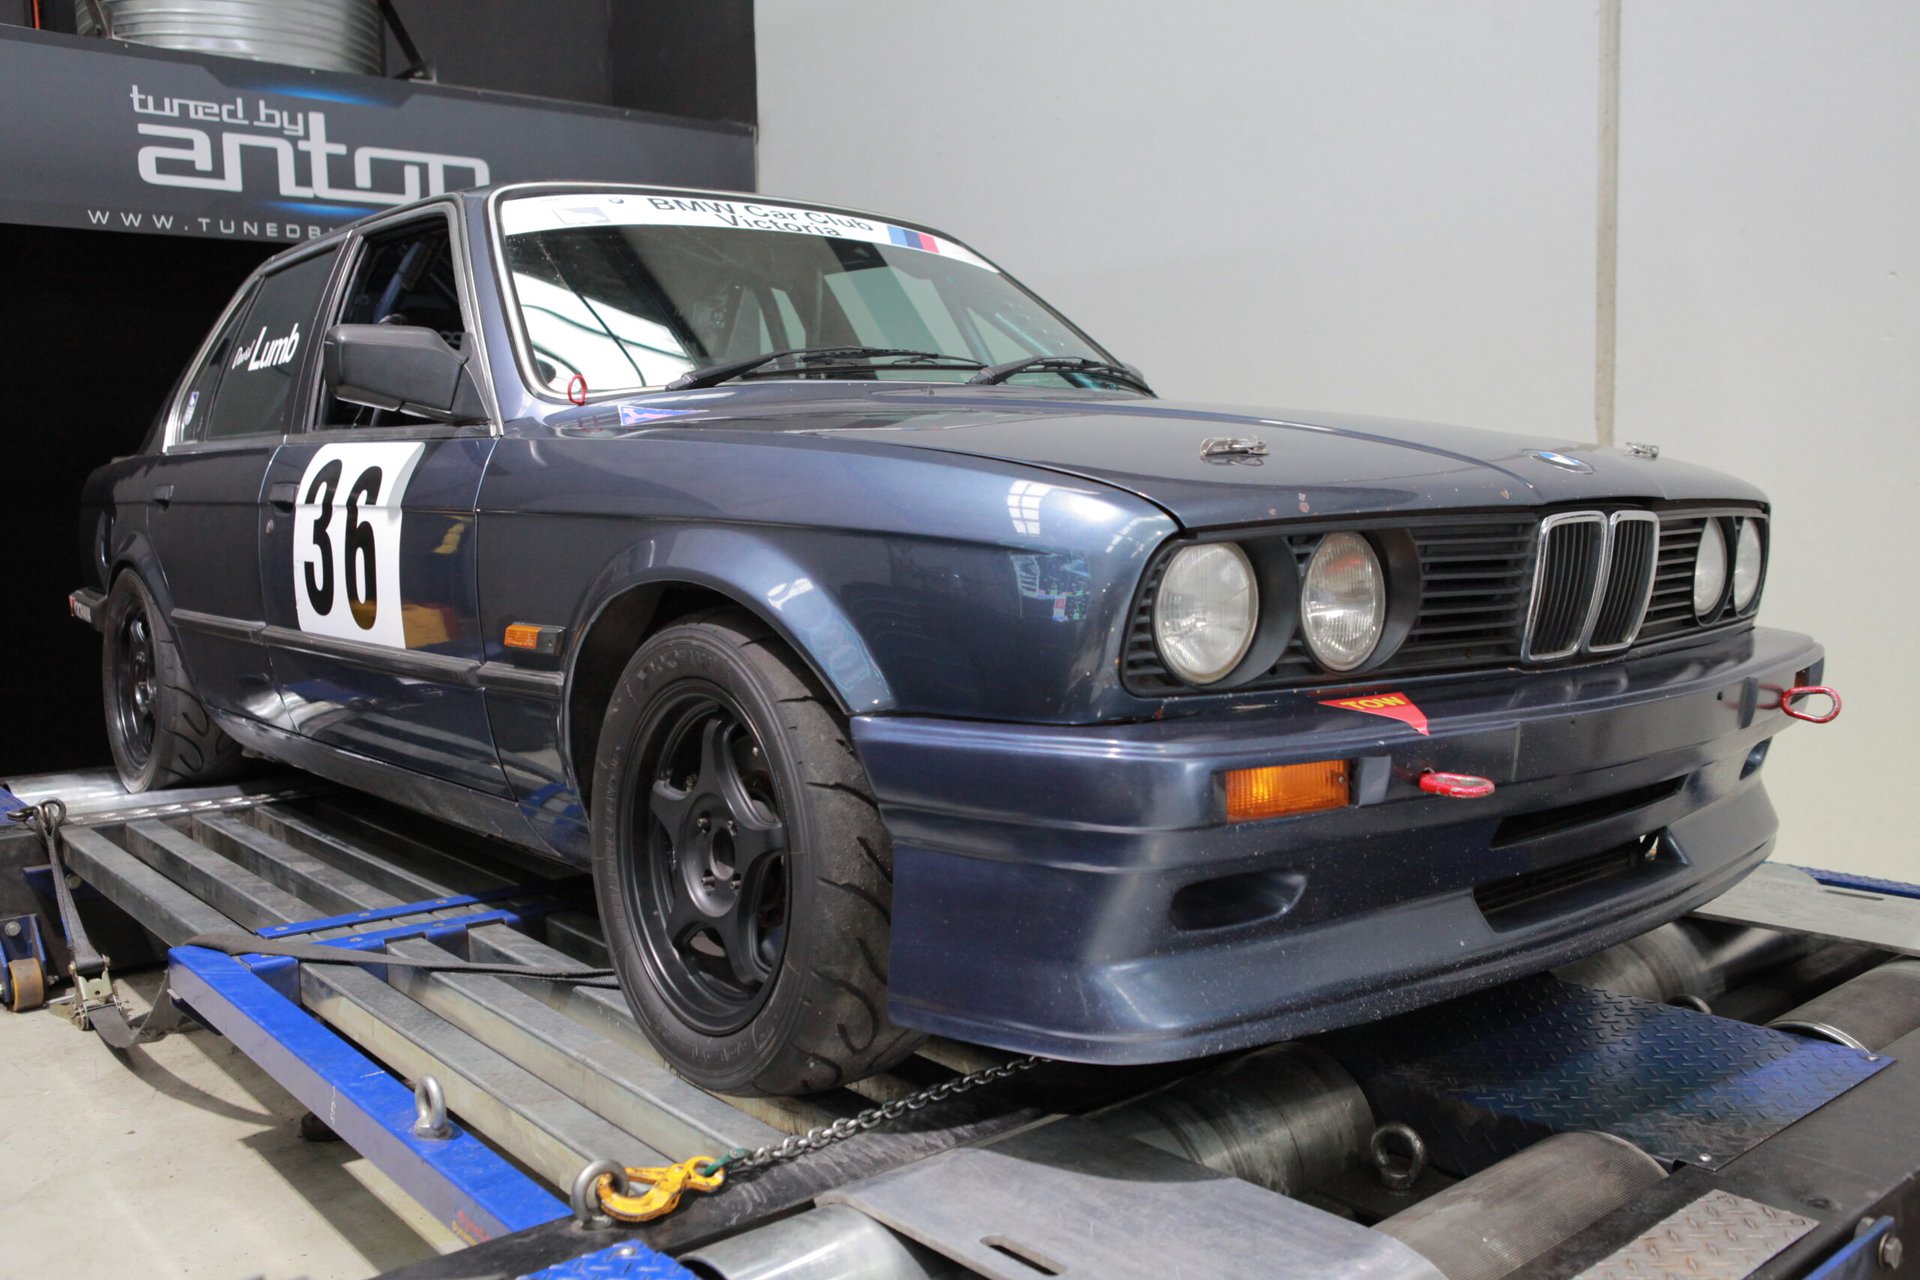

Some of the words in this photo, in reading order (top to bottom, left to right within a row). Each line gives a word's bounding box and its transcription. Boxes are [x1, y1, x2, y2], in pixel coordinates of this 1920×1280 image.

[130, 84, 249, 125] tuned
[253, 99, 304, 136] by
[137, 111, 491, 202] anton
[87, 209, 333, 241] WWW.TUNEDB
[646, 197, 736, 214] BMW
[743, 204, 798, 220] Car
[804, 211, 874, 231] Club
[714, 213, 842, 236] Victoria
[248, 322, 300, 372] Lumb
[304, 459, 384, 631] 36
[1339, 696, 1406, 710] TOW
